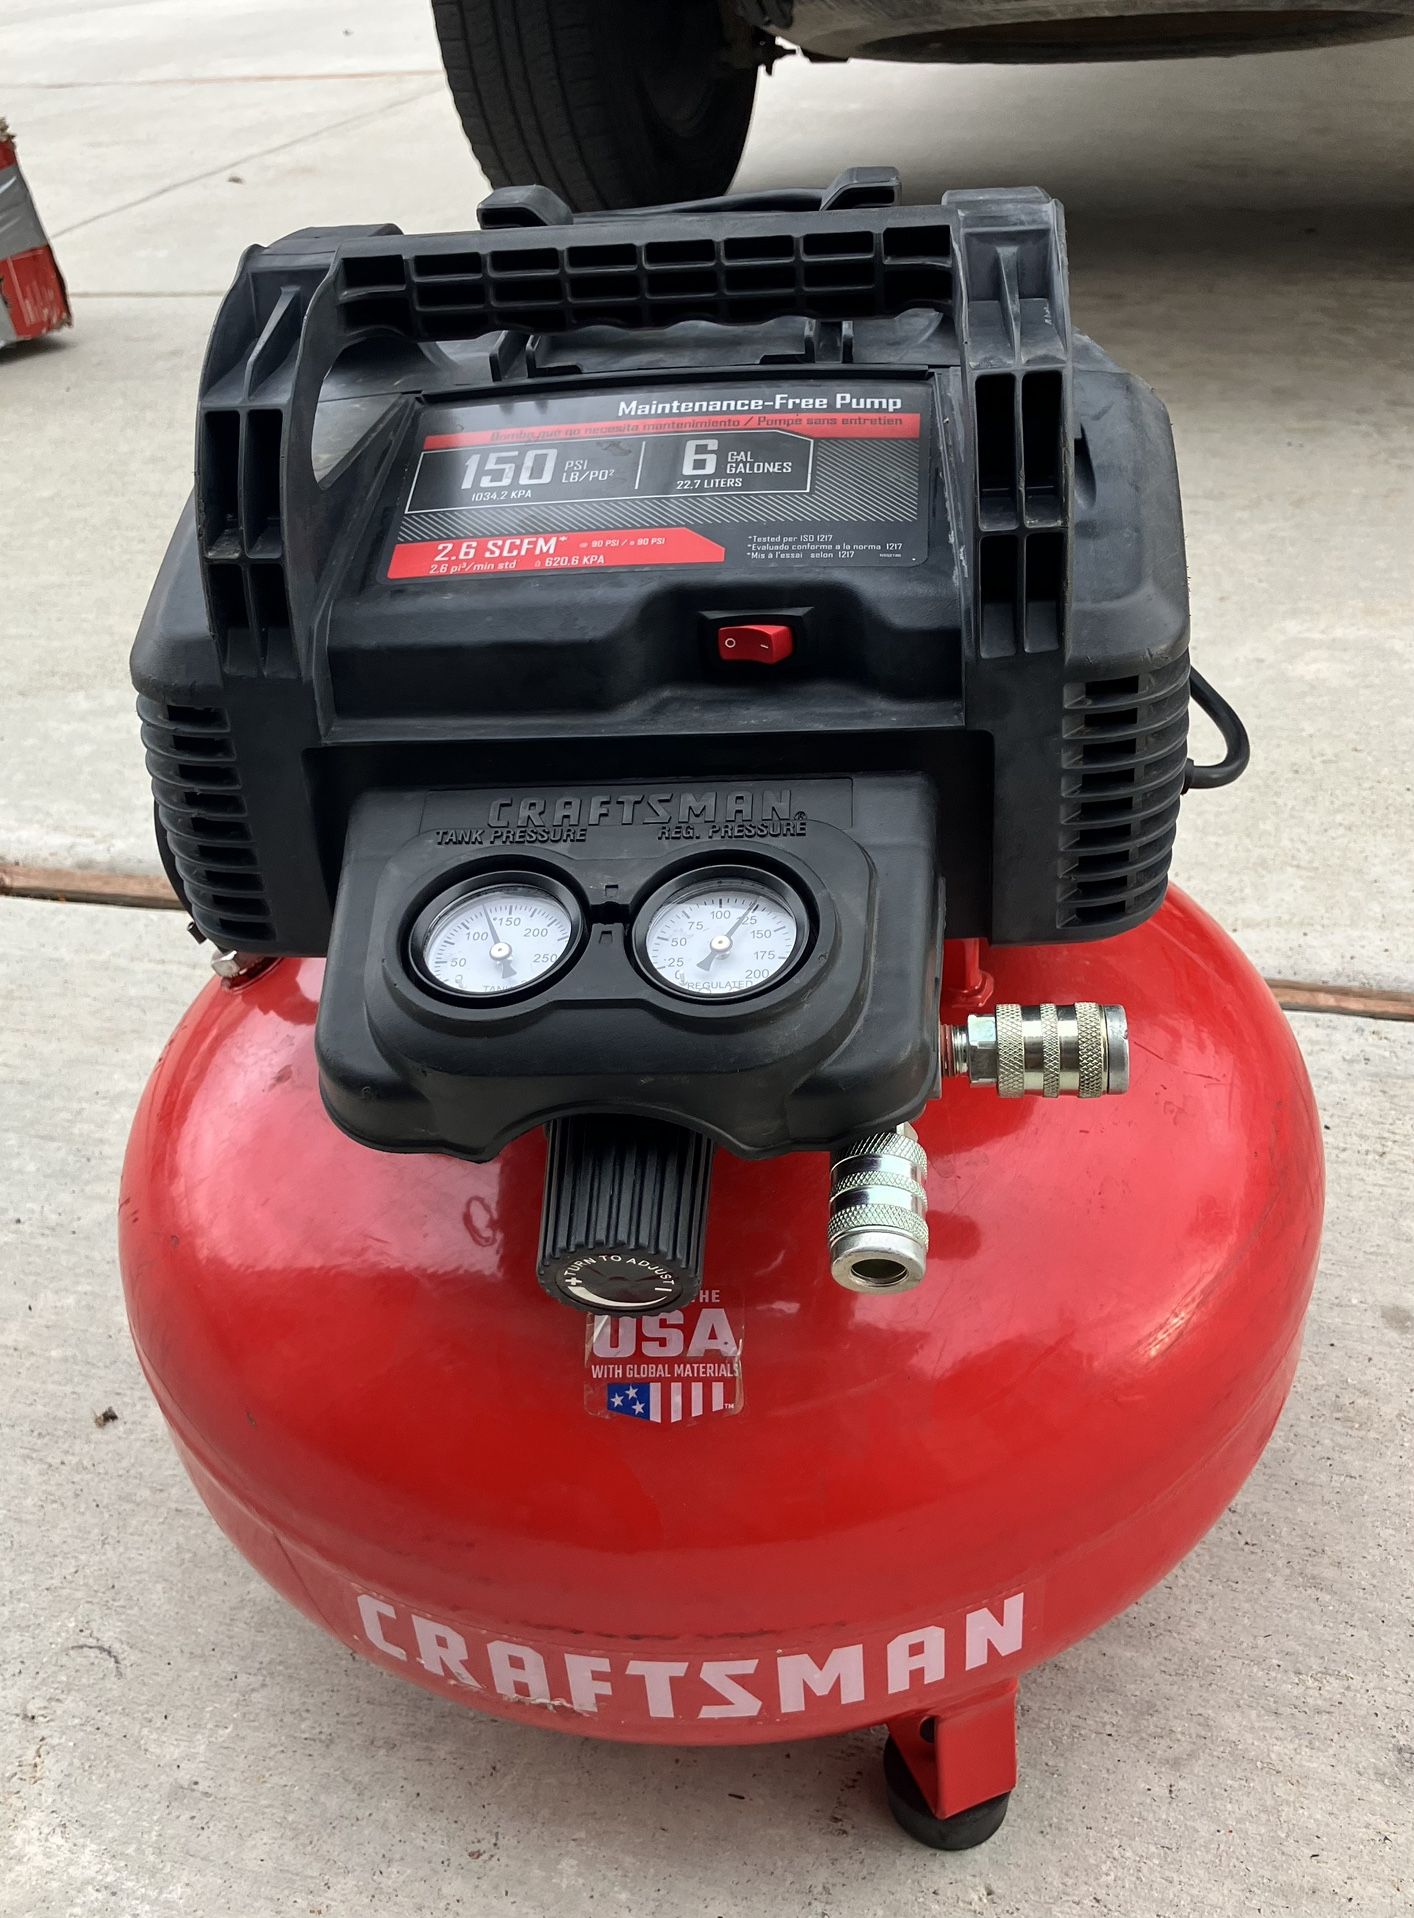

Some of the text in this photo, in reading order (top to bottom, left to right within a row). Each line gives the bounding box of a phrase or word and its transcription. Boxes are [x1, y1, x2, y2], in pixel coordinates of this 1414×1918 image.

[618, 393, 902, 416] Maintenance-Free Pump
[643, 419, 740, 431] mantenimiento
[806, 417, 837, 425] sans
[842, 416, 903, 425] entretien
[682, 439, 718, 475] 6
[728, 451, 754, 462] GAL
[461, 449, 558, 489] 150
[565, 460, 588, 471] PSI
[726, 462, 792, 474] GALONES
[676, 478, 742, 490] 22.7 LITERS
[472, 489, 532, 501] 1034.2 KPA
[783, 536, 797, 544] per
[434, 541, 477, 561] 2.6
[605, 539, 620, 547] PSI
[651, 537, 665, 545] PSI
[792, 543, 833, 551] conforme
[838, 551, 855, 559] 1217
[429, 564, 448, 574] 2.6
[498, 560, 517, 570] std
[545, 556, 580, 567] 620.6
[582, 555, 605, 565] KPA
[436, 828, 588, 846] TANK PRESSURE
[658, 821, 807, 841] REG. PRESSURE
[499, 916, 521, 926] 150
[710, 910, 731, 920] 100
[688, 921, 704, 931] 75
[466, 931, 489, 941] 100
[523, 928, 549, 938] 200
[751, 929, 772, 939] 150
[671, 937, 687, 947] 50
[533, 953, 558, 963] 250
[754, 950, 776, 960] 175
[450, 957, 467, 967] 50
[745, 969, 769, 980] 200
[687, 979, 755, 991] REGULATED
[564, 1257, 597, 1276] TURN
[626, 1258, 675, 1285] ADJUST
[691, 1289, 720, 1303] HE
[592, 1308, 738, 1358] USA
[592, 1362, 740, 1379] WITH GLOBAL MATERIALS
[357, 1592, 1025, 1719] CRAFTSMAN
